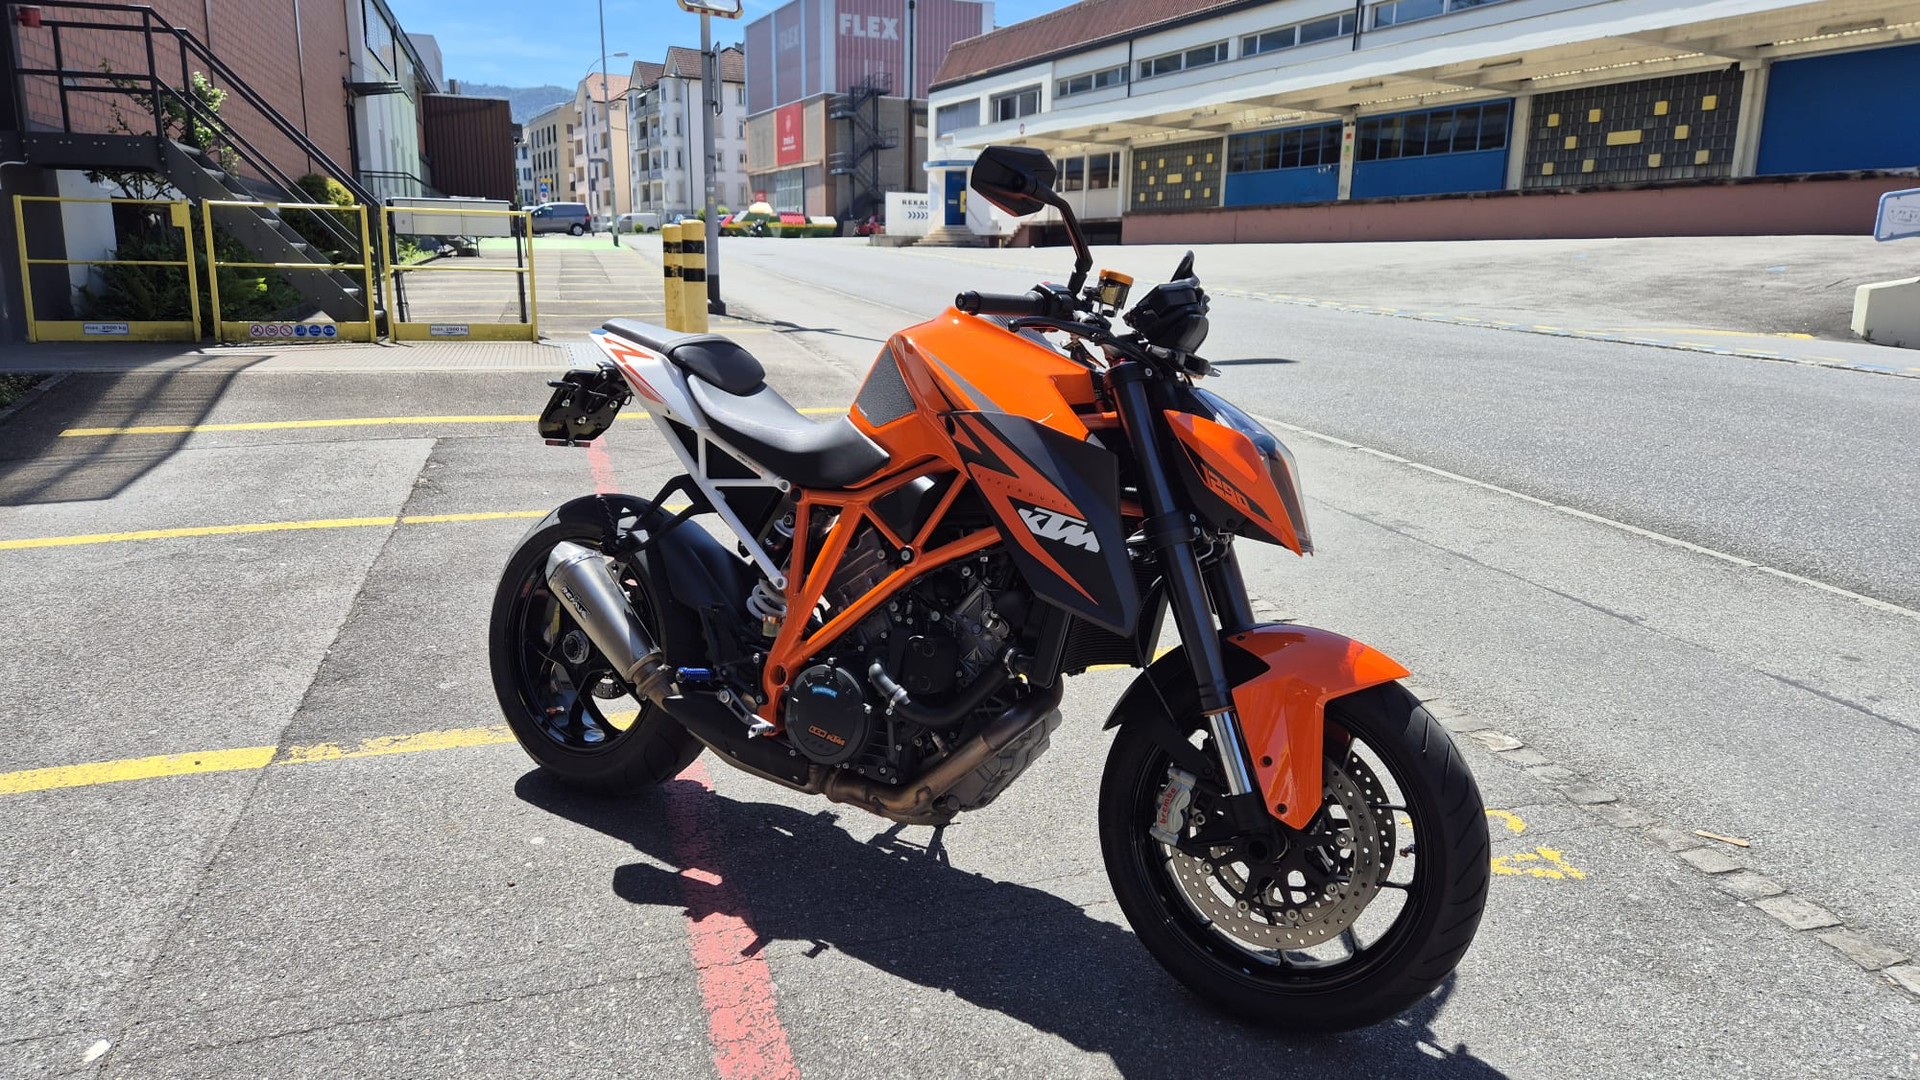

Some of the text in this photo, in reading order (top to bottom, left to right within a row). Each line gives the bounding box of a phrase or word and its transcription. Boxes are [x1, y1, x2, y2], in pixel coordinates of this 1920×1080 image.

[839, 13, 899, 40] FLEX
[1018, 506, 1100, 553] KTM
[1159, 787, 1177, 826] brembo
